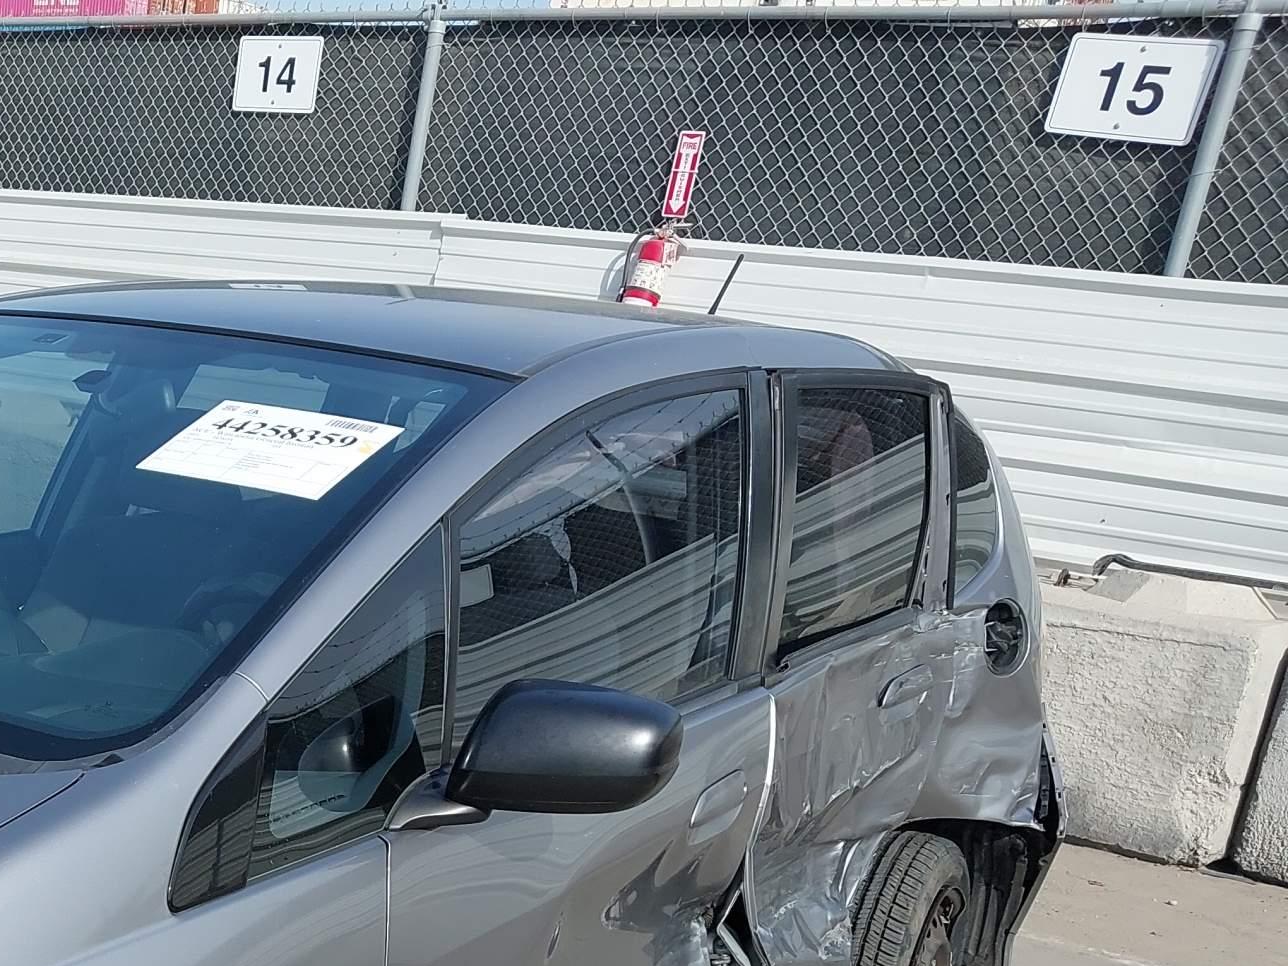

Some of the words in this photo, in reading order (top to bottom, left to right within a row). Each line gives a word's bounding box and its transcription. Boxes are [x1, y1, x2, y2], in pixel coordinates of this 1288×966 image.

[258, 55, 296, 93] 14
[1099, 61, 1172, 116] 15
[682, 141, 698, 150] FIRE
[674, 152, 691, 201] EXTIGUISHER
[212, 417, 359, 448] 44258359
